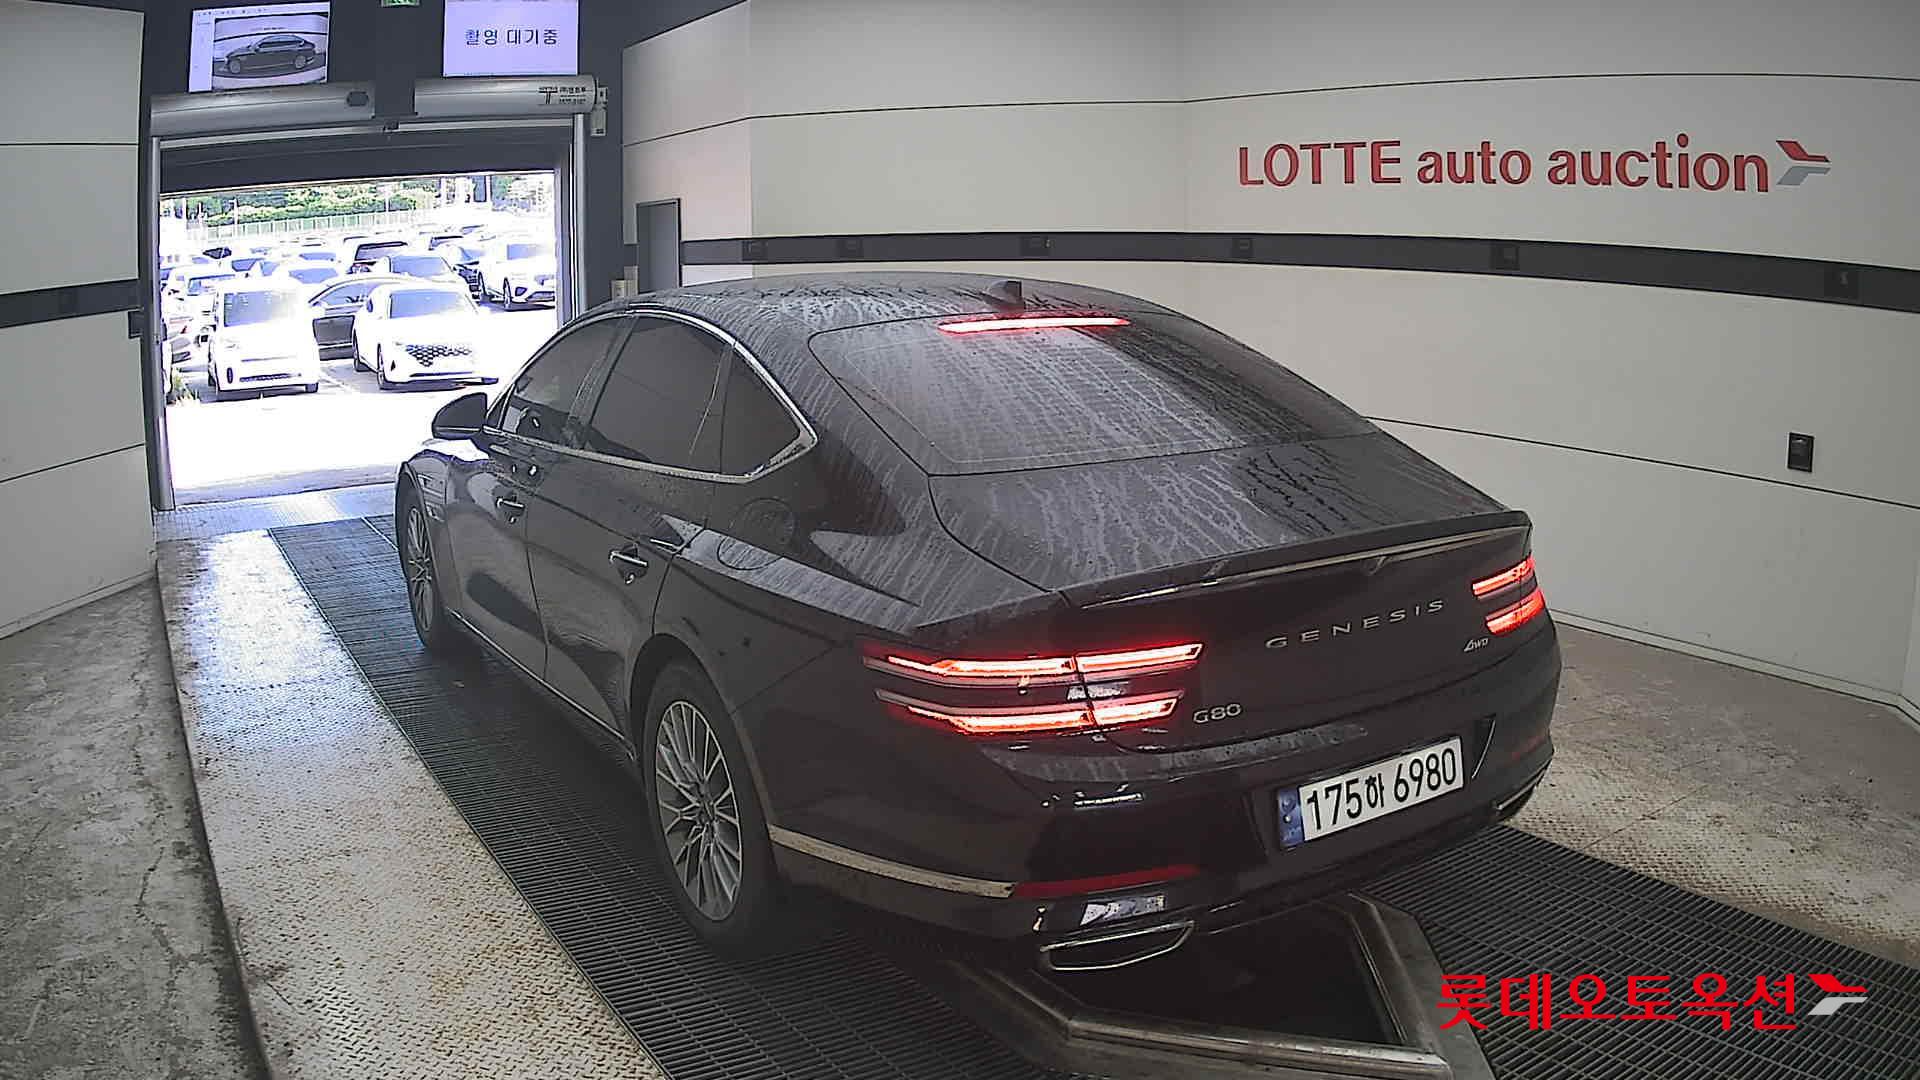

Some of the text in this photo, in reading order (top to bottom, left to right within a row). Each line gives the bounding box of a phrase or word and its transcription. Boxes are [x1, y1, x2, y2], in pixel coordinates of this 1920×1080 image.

[1239, 132, 1769, 193] LOTTE auto auction
[1265, 599, 1444, 650] GENESIS
[1463, 636, 1489, 652] AWD
[1193, 703, 1242, 724] G80
[1307, 748, 1457, 830] 175하 6980
